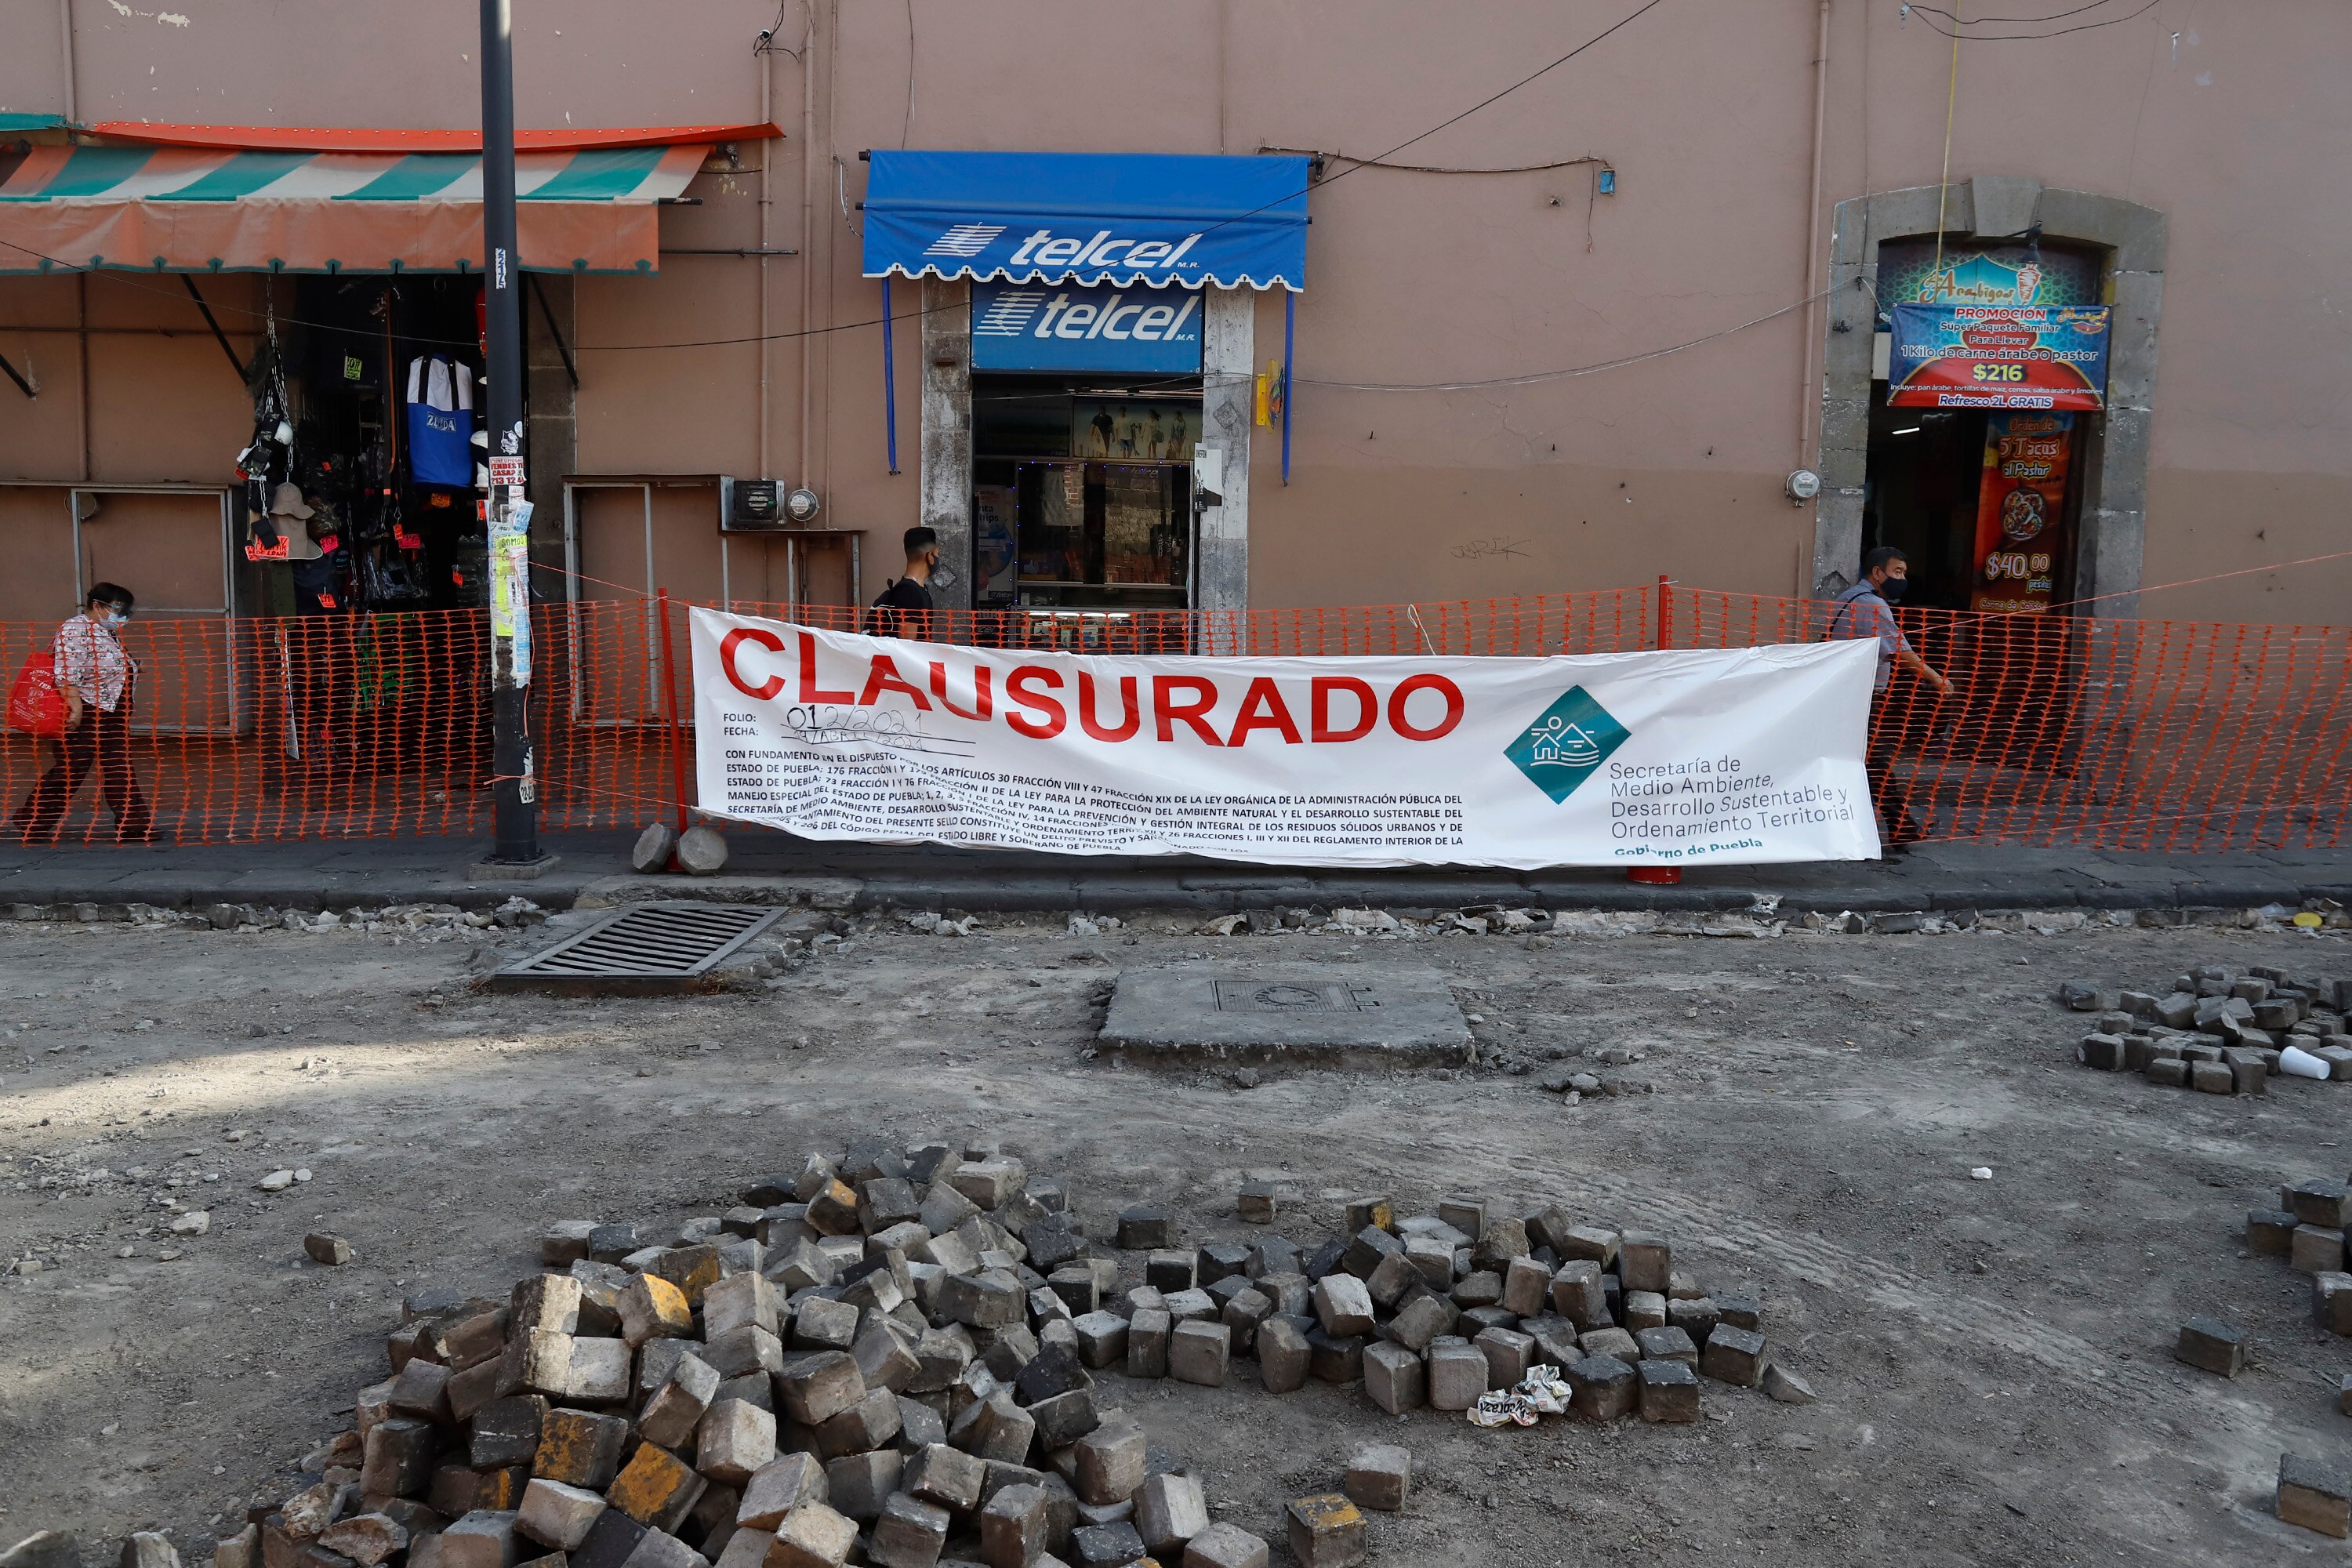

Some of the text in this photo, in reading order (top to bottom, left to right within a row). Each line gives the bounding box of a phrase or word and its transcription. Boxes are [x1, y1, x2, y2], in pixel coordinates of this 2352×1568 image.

[1010, 230, 1203, 267] telcel
[1035, 293, 1200, 340] telcel
[1955, 307, 2045, 321] PROMOCIÓN
[1940, 322, 2060, 332] Súper Paquete Familiar
[1901, 346, 1907, 356] 1
[1909, 346, 1935, 357] Kilo
[1937, 348, 1955, 358] de
[1958, 350, 1994, 359] carne
[1998, 350, 2037, 360] árabe
[2052, 350, 2097, 361] pastor
[1973, 363, 2023, 382] $216
[1940, 395, 2053, 408] Refresco 2L GRATIS
[2010, 416, 2055, 431] Orden de
[1999, 436, 2059, 456] 5 Tacos
[2004, 462, 2050, 477] al Pastor
[1980, 599, 2004, 609] Carne
[2007, 600, 2016, 610] de
[720, 628, 1464, 747] CLAUSURADO
[724, 713, 756, 722] FOLIO:
[724, 727, 758, 735] FECHA:
[1610, 755, 1740, 779] Secretaría de
[726, 750, 746, 759] CON
[749, 750, 819, 760] FUNDAMENTO
[850, 753, 897, 762] DISPUESTO
[922, 764, 938, 774] LOS
[941, 767, 995, 781] ARTÍCULOS
[998, 774, 1010, 782] 30
[1012, 775, 1061, 789] FRACCIÓN
[1065, 782, 1080, 790] VIII
[1105, 788, 1152, 803] FRACCIÓN
[1225, 795, 1276, 804] ORGÁNICA
[1279, 796, 1291, 804] DE
[1294, 796, 1305, 804] LA
[1308, 793, 1396, 804] ADMINISTRACIÓN
[1399, 793, 1442, 804] PÚBLICA
[1611, 775, 1773, 797] Medio Ambiente,
[848, 764, 891, 775] FRACCIÓN
[1025, 791, 1041, 800] LEY
[1045, 793, 1070, 804] PARA
[1075, 796, 1086, 805] LA
[1091, 799, 1151, 814] PROTECCIÓN
[1232, 808, 1277, 818] NATURAL
[1291, 809, 1302, 818] EL
[1306, 809, 1370, 818] DESARROLLO
[1374, 809, 1440, 818] SUSTENTABLE
[1445, 809, 1463, 818] DEL
[1612, 784, 1847, 817] Desarrollo Sustentable y
[784, 775, 822, 786] PUEBLA;
[840, 779, 888, 787] FRACCIÓN
[1029, 804, 1054, 814] PARA
[1074, 811, 1137, 825] PREVENCIÓN
[1151, 818, 1192, 829] GESTIÓN
[1196, 821, 1245, 831] INTEGRAL
[1265, 822, 1283, 831] LOS
[1341, 822, 1383, 832] SÓLIDOS
[1387, 823, 1436, 832] URBANOS
[728, 791, 768, 800] MANEJO
[771, 790, 811, 800] ESPECIAL
[815, 786, 829, 795] DEL
[833, 789, 869, 800] ESTADO
[889, 792, 924, 800] PUEBLA;
[1018, 812, 1029, 821] IV,
[1183, 832, 1244, 841] FRACCIONES
[1314, 836, 1382, 845] REGLAMENTO
[728, 804, 783, 814] SECRETARÍA
[800, 797, 828, 811] MEDIO
[831, 800, 884, 814] AMBIENTE,
[888, 804, 946, 814] DESARROLLO
[1022, 822, 1105, 836] ORDENAMIENTO
[887, 818, 934, 827] PRESENTE
[937, 817, 958, 826] SELLO
[1612, 804, 1854, 839] Ordenamiento Territorial
[938, 831, 967, 840] ESTADO
[971, 833, 996, 841] LIBRE
[1009, 835, 1063, 848] SOBERANO
[1688, 845, 1706, 855] de
[1710, 838, 1762, 852] Puebla
